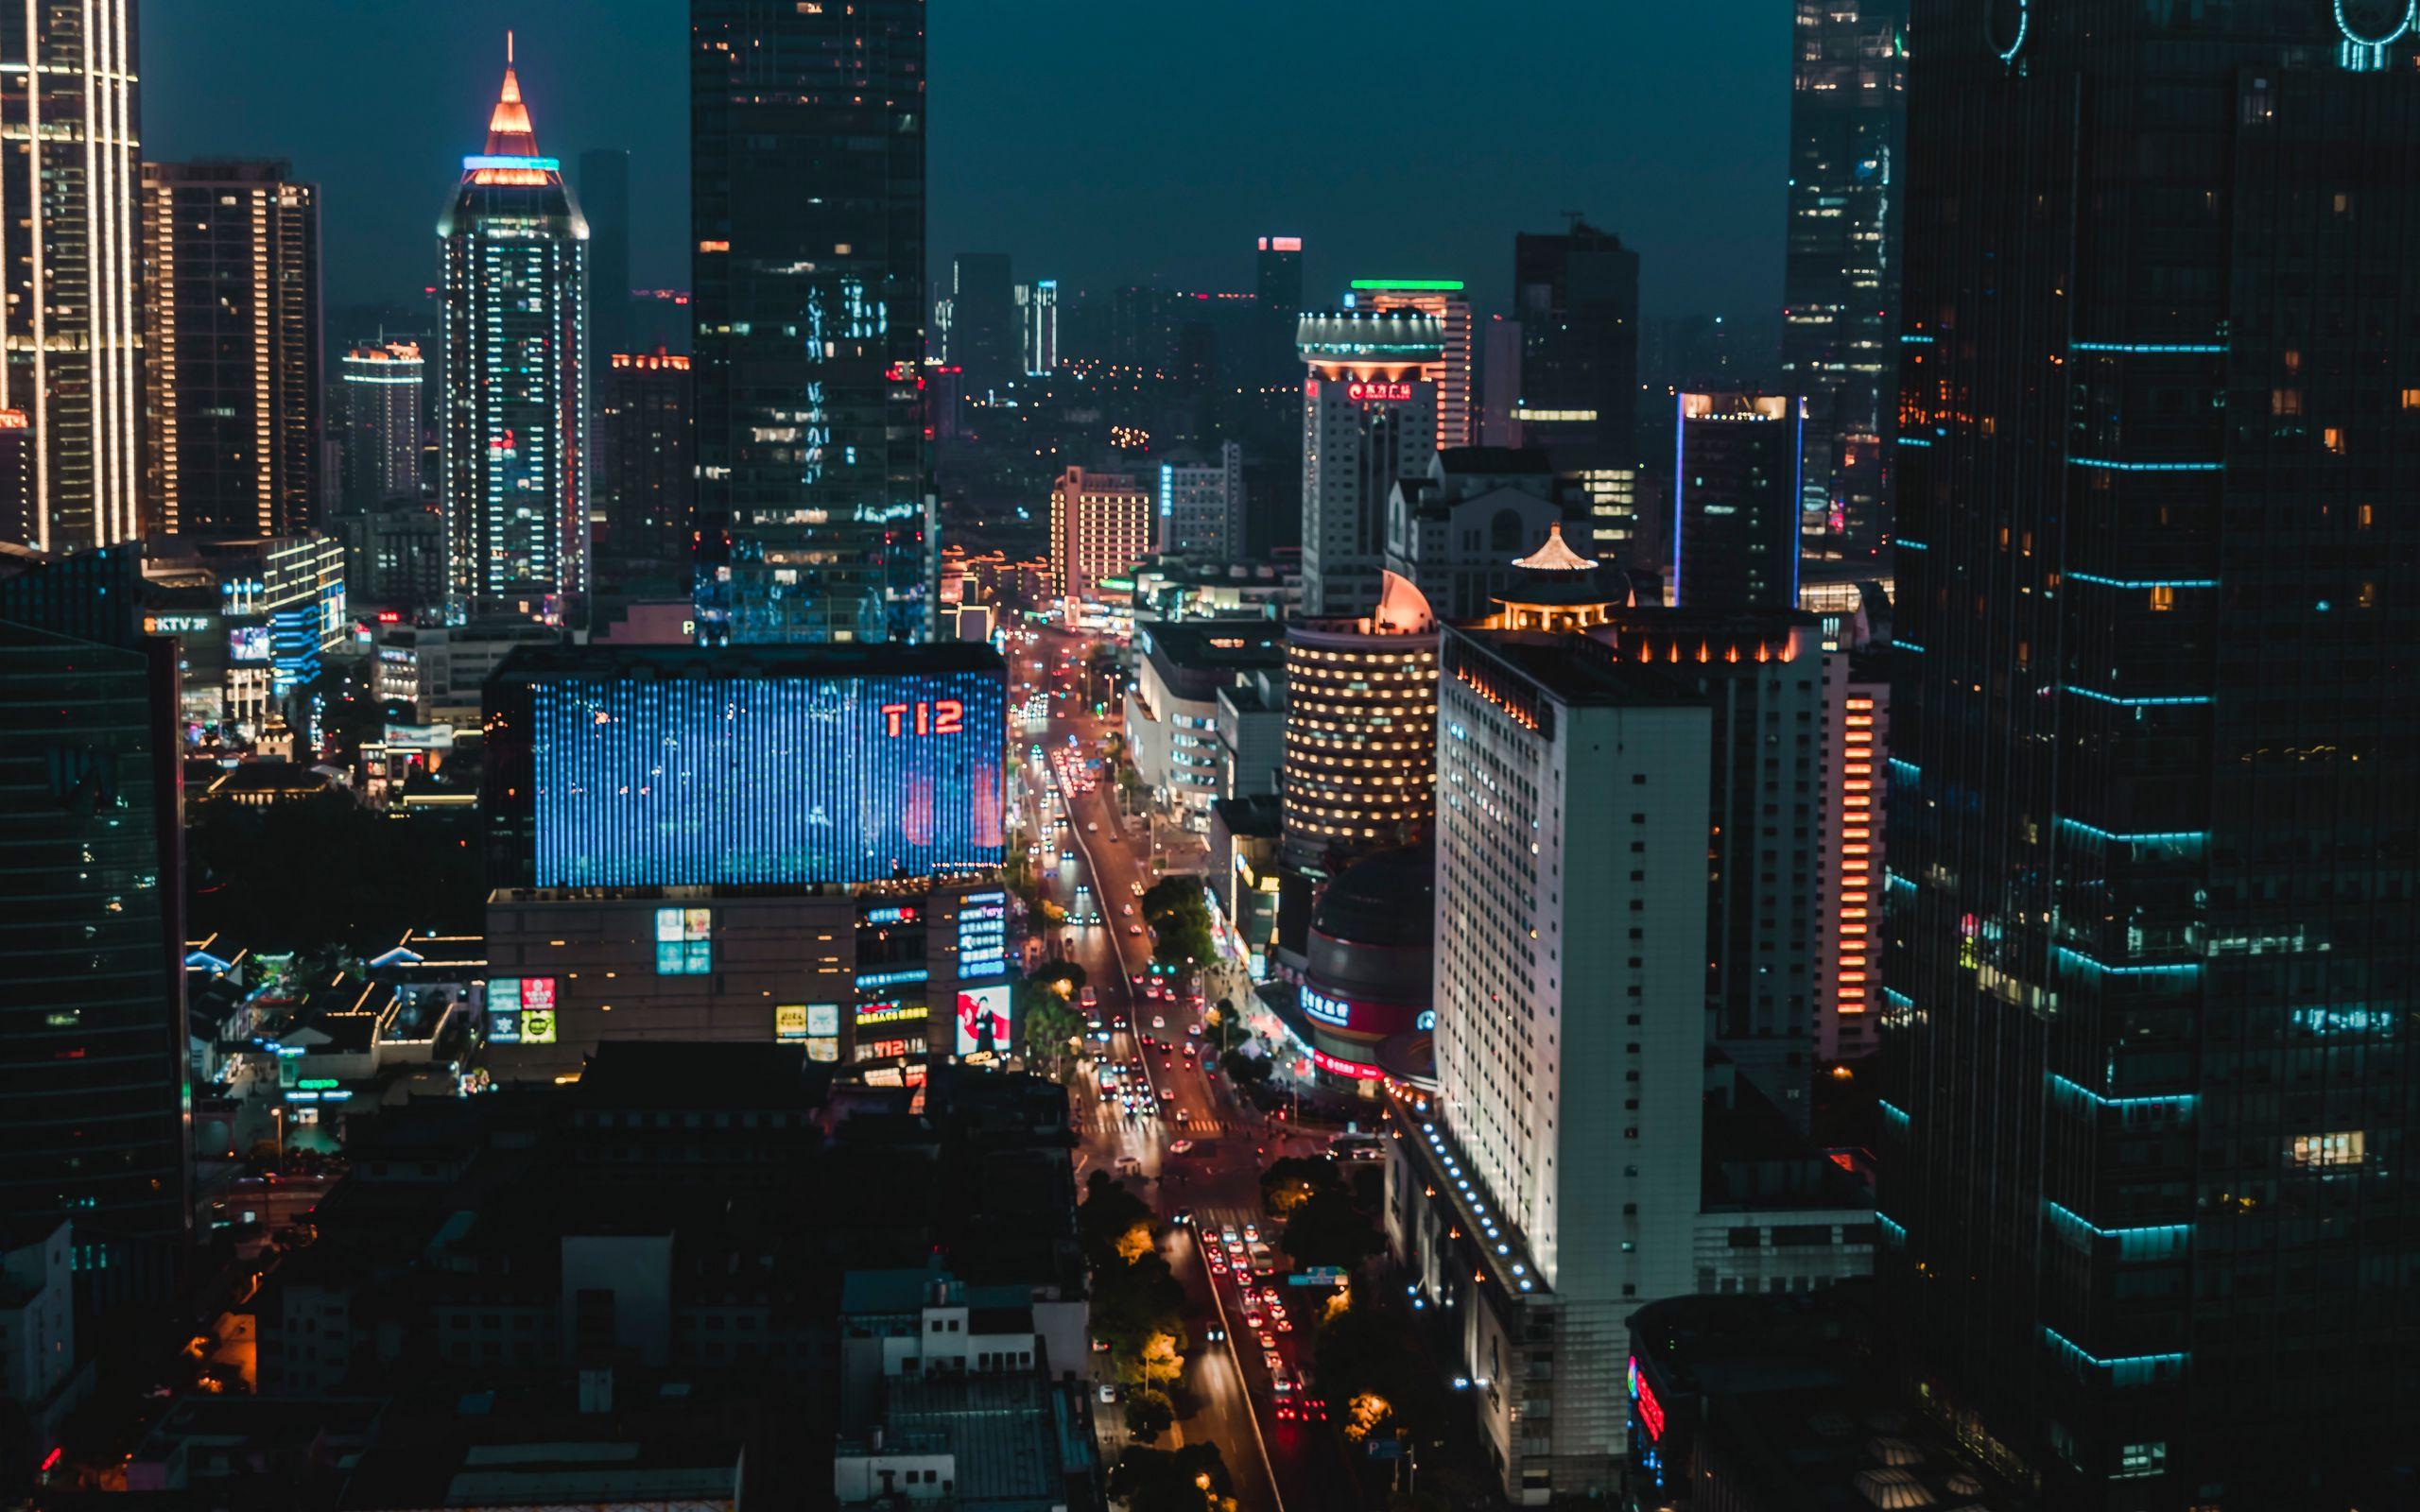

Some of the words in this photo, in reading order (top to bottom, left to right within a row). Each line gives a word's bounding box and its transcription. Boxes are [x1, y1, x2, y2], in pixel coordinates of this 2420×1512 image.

[157, 617, 192, 631] KTV
[881, 700, 963, 737] T12
[873, 1039, 905, 1058] T12
